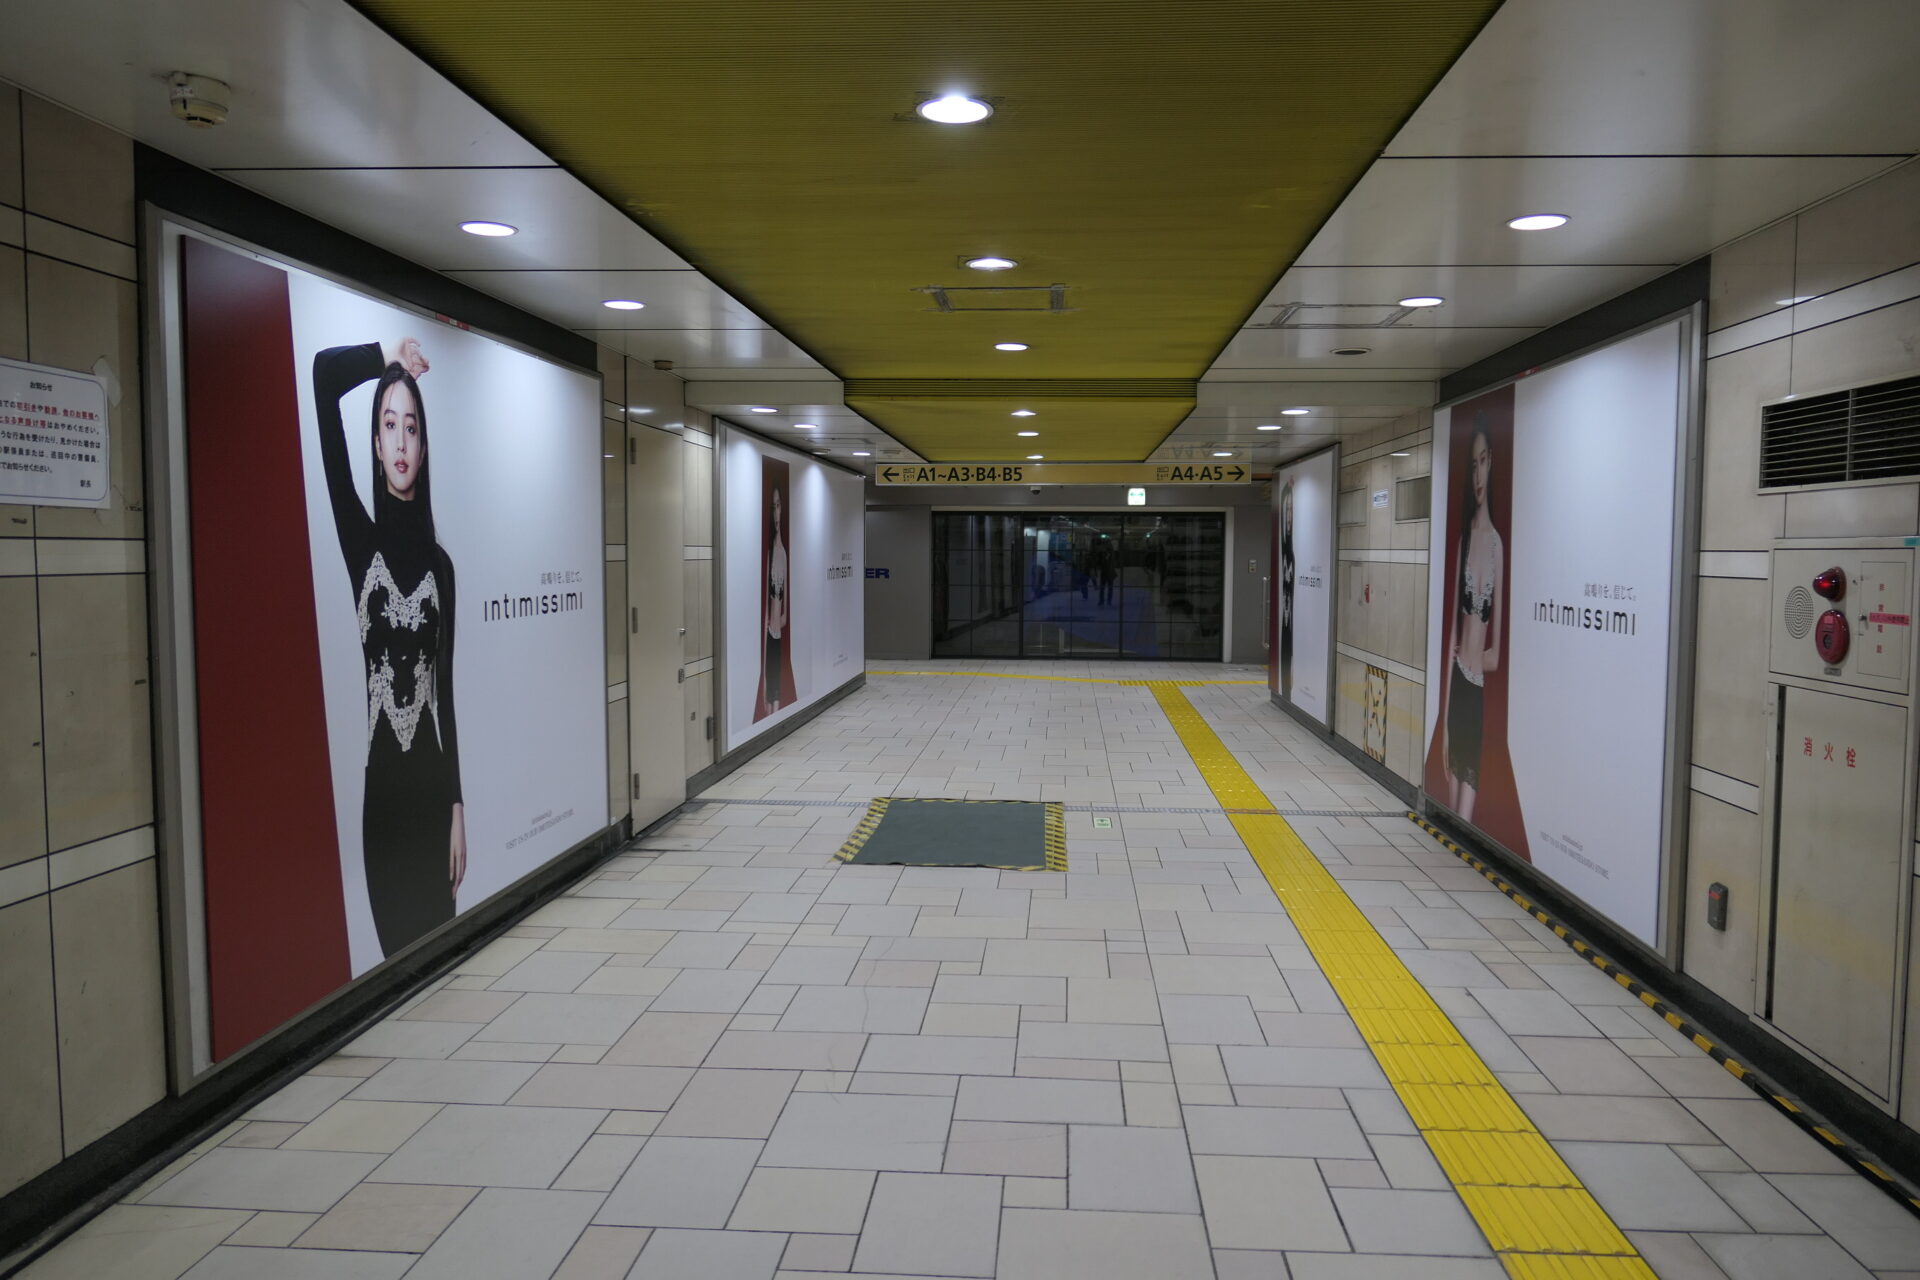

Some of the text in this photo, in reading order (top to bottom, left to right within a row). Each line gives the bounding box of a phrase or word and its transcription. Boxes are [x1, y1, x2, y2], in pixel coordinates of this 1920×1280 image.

[30, 381, 53, 392] お知らせ
[484, 591, 583, 622] intimissimi
[1534, 598, 1636, 636] intimissimi
[1803, 736, 1857, 769] 消火栓
